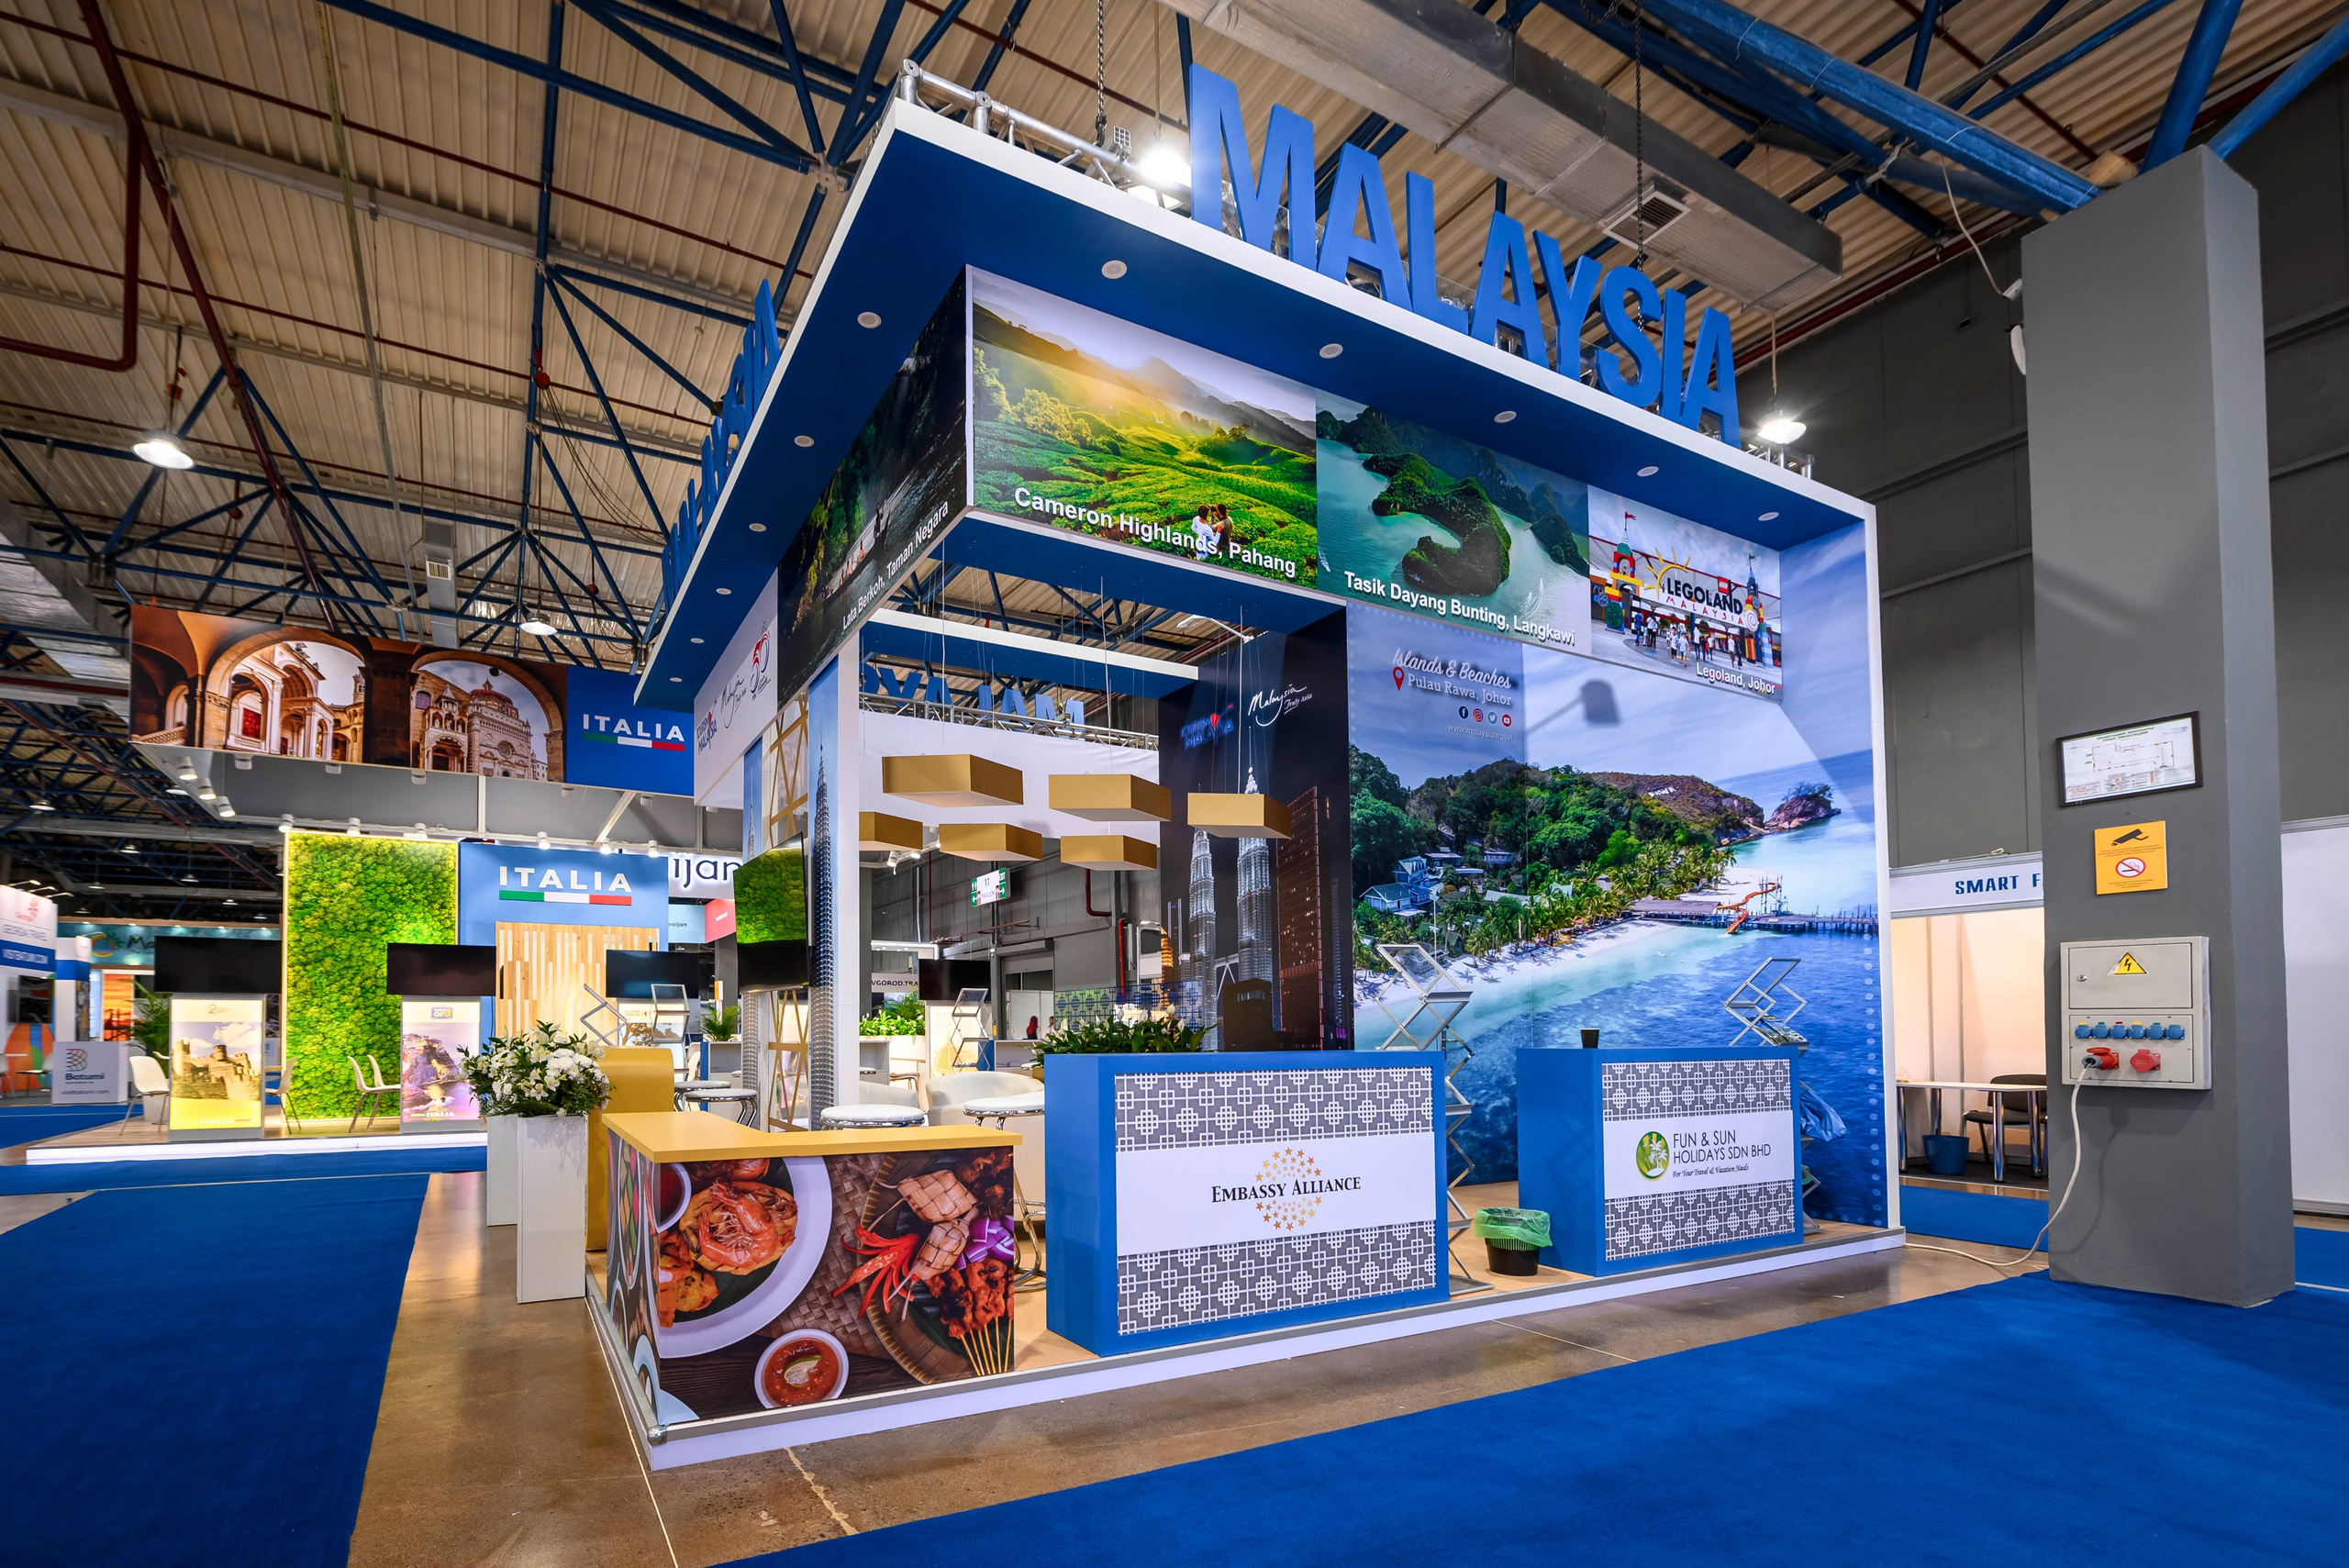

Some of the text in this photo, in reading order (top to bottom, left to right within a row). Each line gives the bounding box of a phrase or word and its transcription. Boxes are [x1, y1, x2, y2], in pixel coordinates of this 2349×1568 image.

[1188, 62, 1742, 450] MALAYSIA
[1014, 487, 1296, 578] Cameron Highlands, Pahang
[842, 500, 949, 630] Lata Berkoh, Taman Negara
[1344, 571, 1575, 646] Tasik Dayang Bunting, Langkawi
[1666, 577, 1743, 616] LEGOLAND
[1666, 596, 1743, 626] MALAYSIA
[1391, 648, 1512, 689] Islands & Beaches
[1697, 662, 1776, 695] Legoland, Johor
[1247, 684, 1308, 727] Malaysia
[1407, 673, 1512, 706] Pulau Rawa, Johor
[583, 714, 685, 742] ITALIA
[1184, 719, 1234, 751] MALAYSIA
[1447, 723, 1513, 742] www.malaysia.travel
[499, 866, 632, 893] ITALIA
[1955, 874, 2019, 895] SMART
[1673, 1129, 1736, 1149] FUN & SUN
[1673, 1144, 1771, 1164] HOLIDAYS SDN BHD
[1682, 1169, 1694, 1177] Your
[1694, 1166, 1709, 1176] Travel
[1715, 1165, 1734, 1173] Vacation
[1735, 1163, 1749, 1173] Needs
[1211, 1176, 1362, 1203] EMBASSY ALLIANCE
